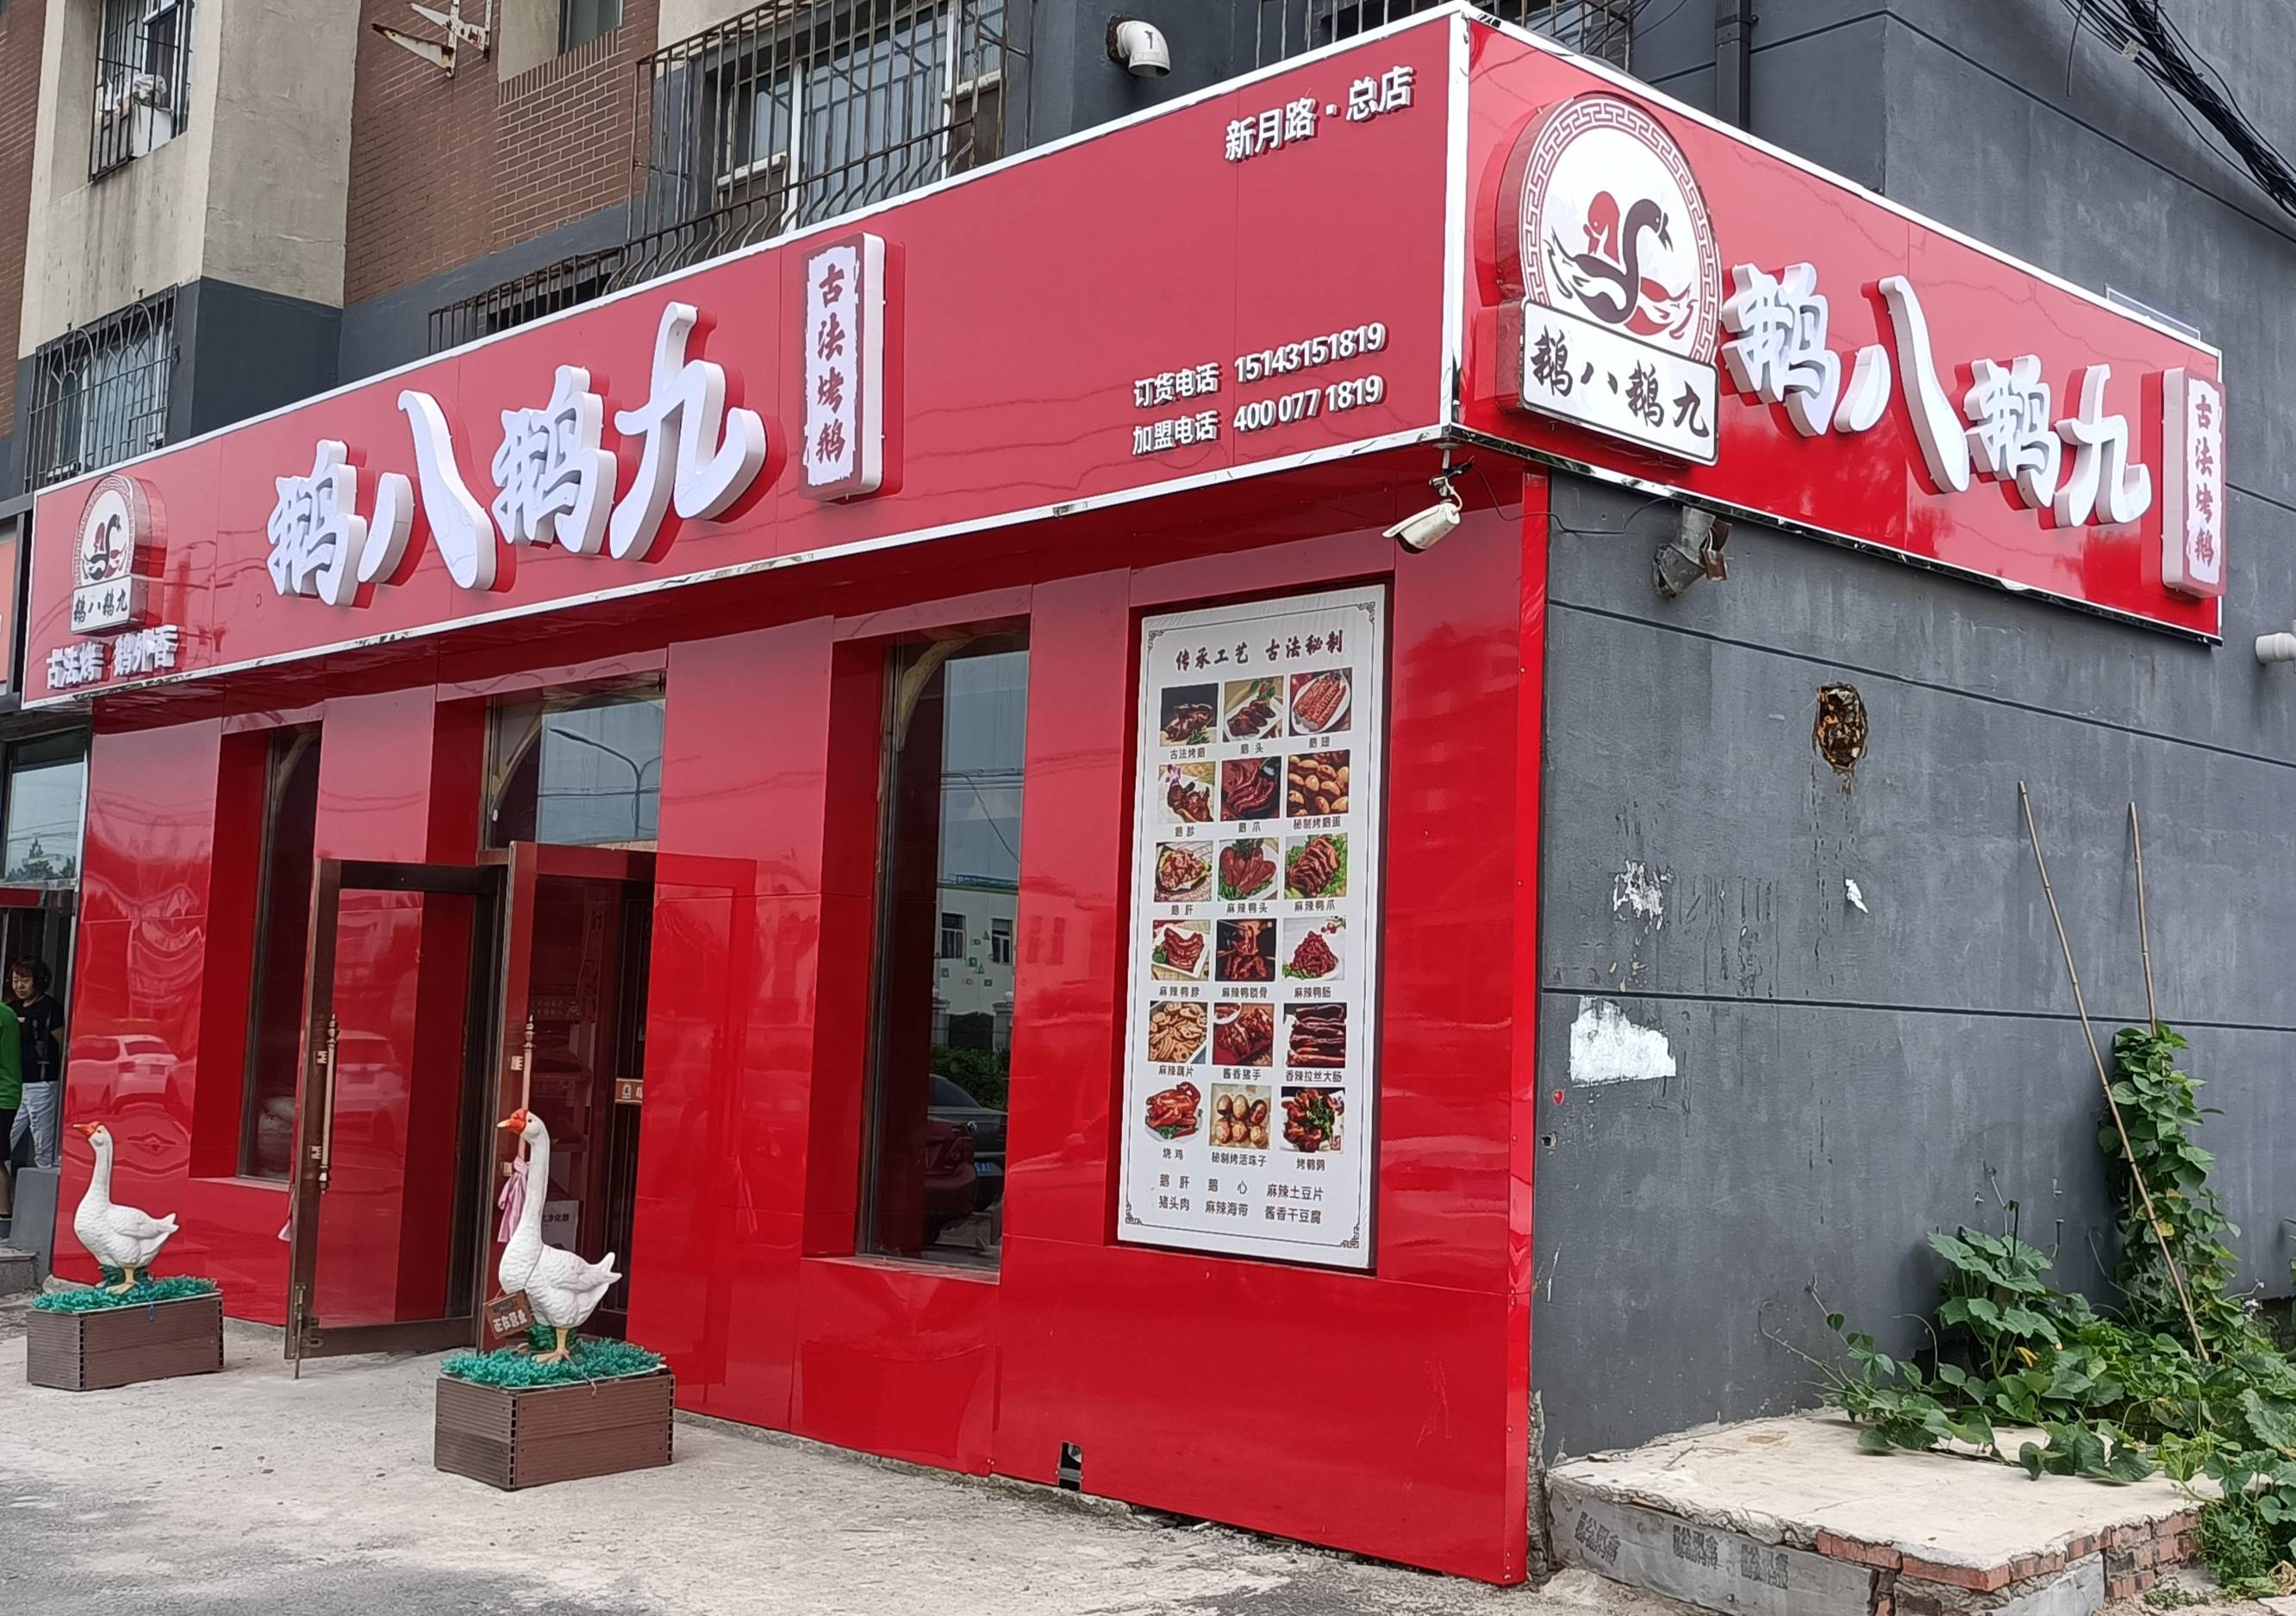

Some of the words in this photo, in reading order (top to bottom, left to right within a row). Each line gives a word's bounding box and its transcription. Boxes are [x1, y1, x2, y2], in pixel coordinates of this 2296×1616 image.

[815, 263, 845, 463] 古法烤鹅
[1133, 361, 1220, 408] 订货电话
[1234, 322, 1388, 384] 15143151819
[1132, 410, 1219, 456] 加盟电话
[1233, 399, 1273, 432] 400
[1277, 388, 1320, 423] 077
[1325, 375, 1385, 411] 1819
[2194, 394, 2215, 567] 古法烤鹅
[46, 641, 104, 689] 古法烤
[1175, 641, 1249, 671] 传承工艺
[1265, 630, 1344, 661] 古法秘制
[1226, 902, 1268, 914] 麻辣鸭头
[1158, 1195, 1190, 1212] 猪头肉
[1205, 1201, 1249, 1217] 麻辣海带
[1266, 1183, 1324, 1201] 麻辣土豆片
[1264, 1206, 1321, 1225] 酱香干豆腐
